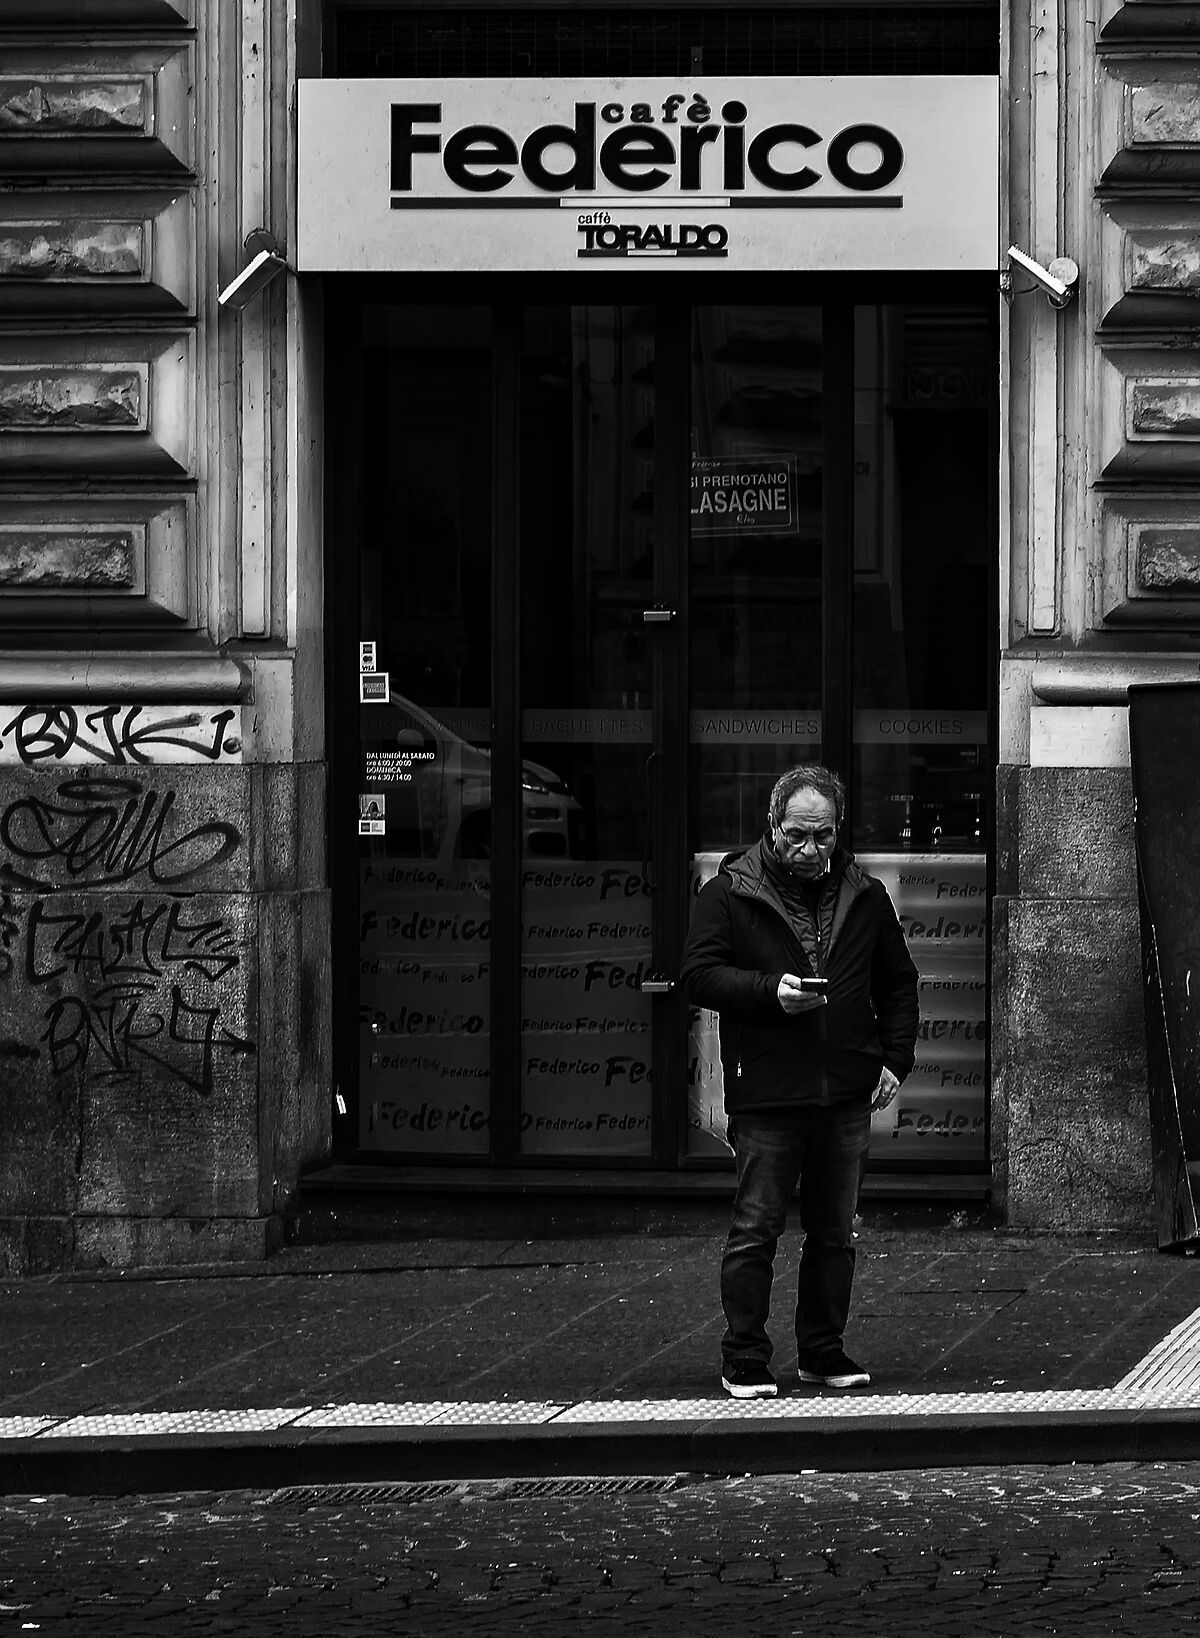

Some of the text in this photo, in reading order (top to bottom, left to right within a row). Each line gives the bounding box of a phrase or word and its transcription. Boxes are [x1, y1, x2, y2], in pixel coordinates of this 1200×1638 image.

[600, 95, 712, 125] cafè
[390, 100, 904, 192] Federico
[577, 212, 612, 226] caffè
[577, 223, 728, 250] TORALDO
[702, 473, 787, 487] PRENOTANO
[693, 718, 819, 735] SANDWICHES
[878, 718, 965, 735] COOKIES
[522, 871, 595, 888] Federico
[528, 921, 651, 939] Federico Federic
[520, 963, 580, 980] ederico
[528, 1057, 600, 1075] Federico
[368, 1101, 491, 1133] Federic
[536, 1116, 593, 1131] Federico
